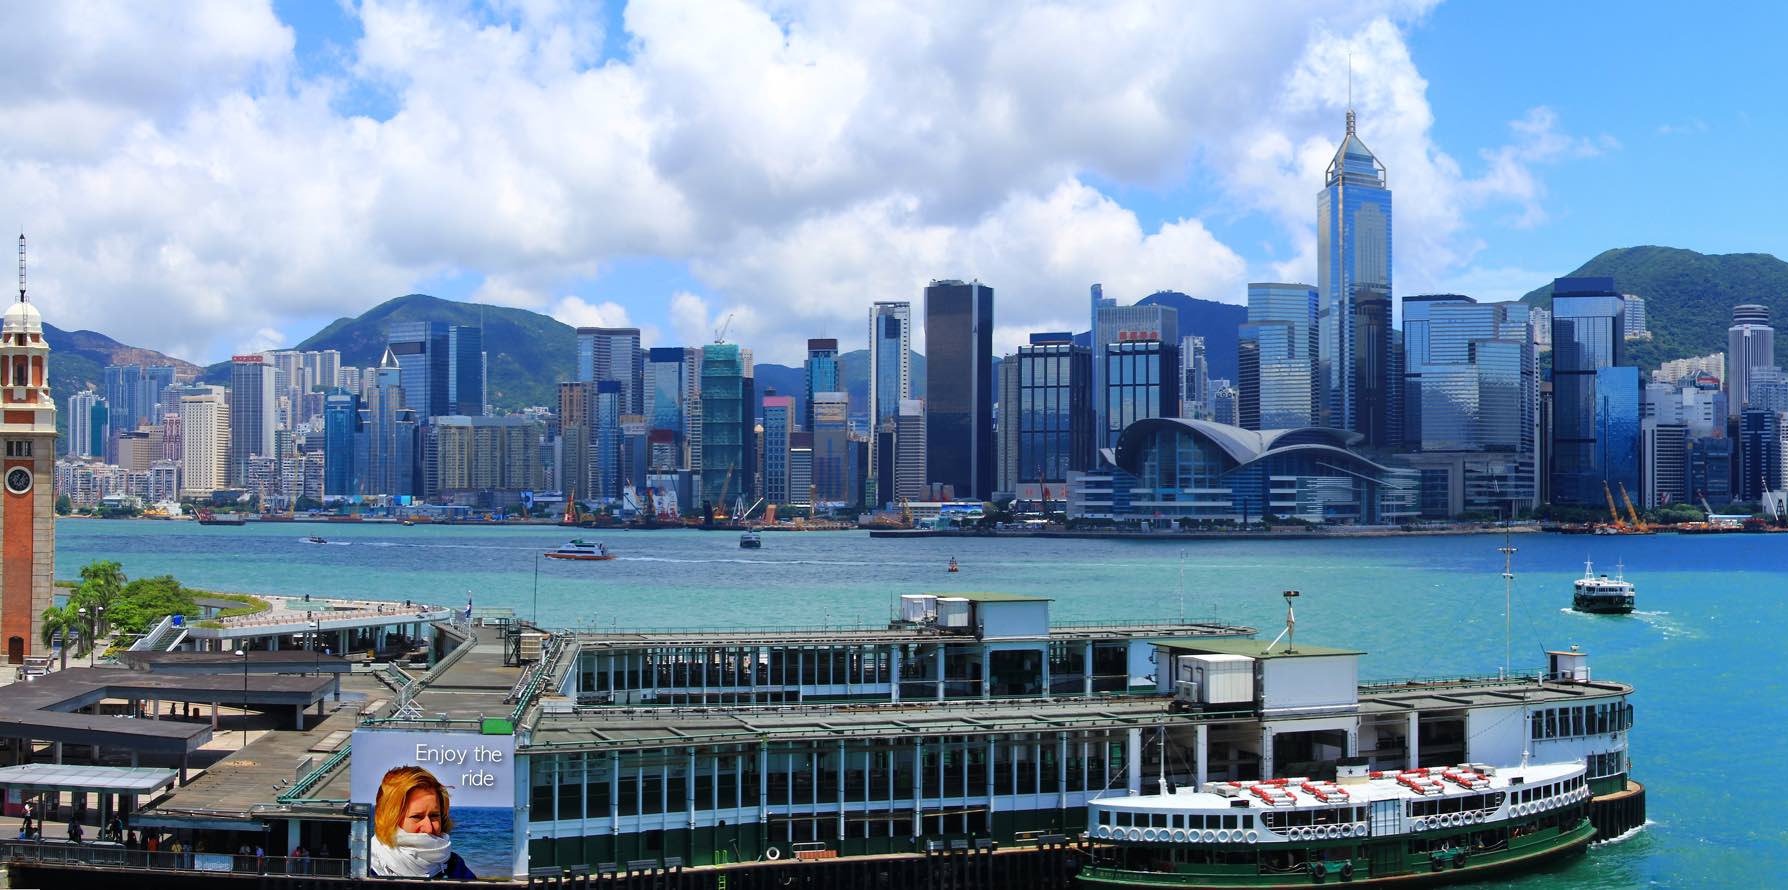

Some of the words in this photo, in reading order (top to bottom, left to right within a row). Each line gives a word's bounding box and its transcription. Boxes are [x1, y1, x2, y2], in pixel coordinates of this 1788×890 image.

[416, 744, 467, 765] Enjoy
[474, 745, 502, 762] the
[462, 769, 494, 786] ride
